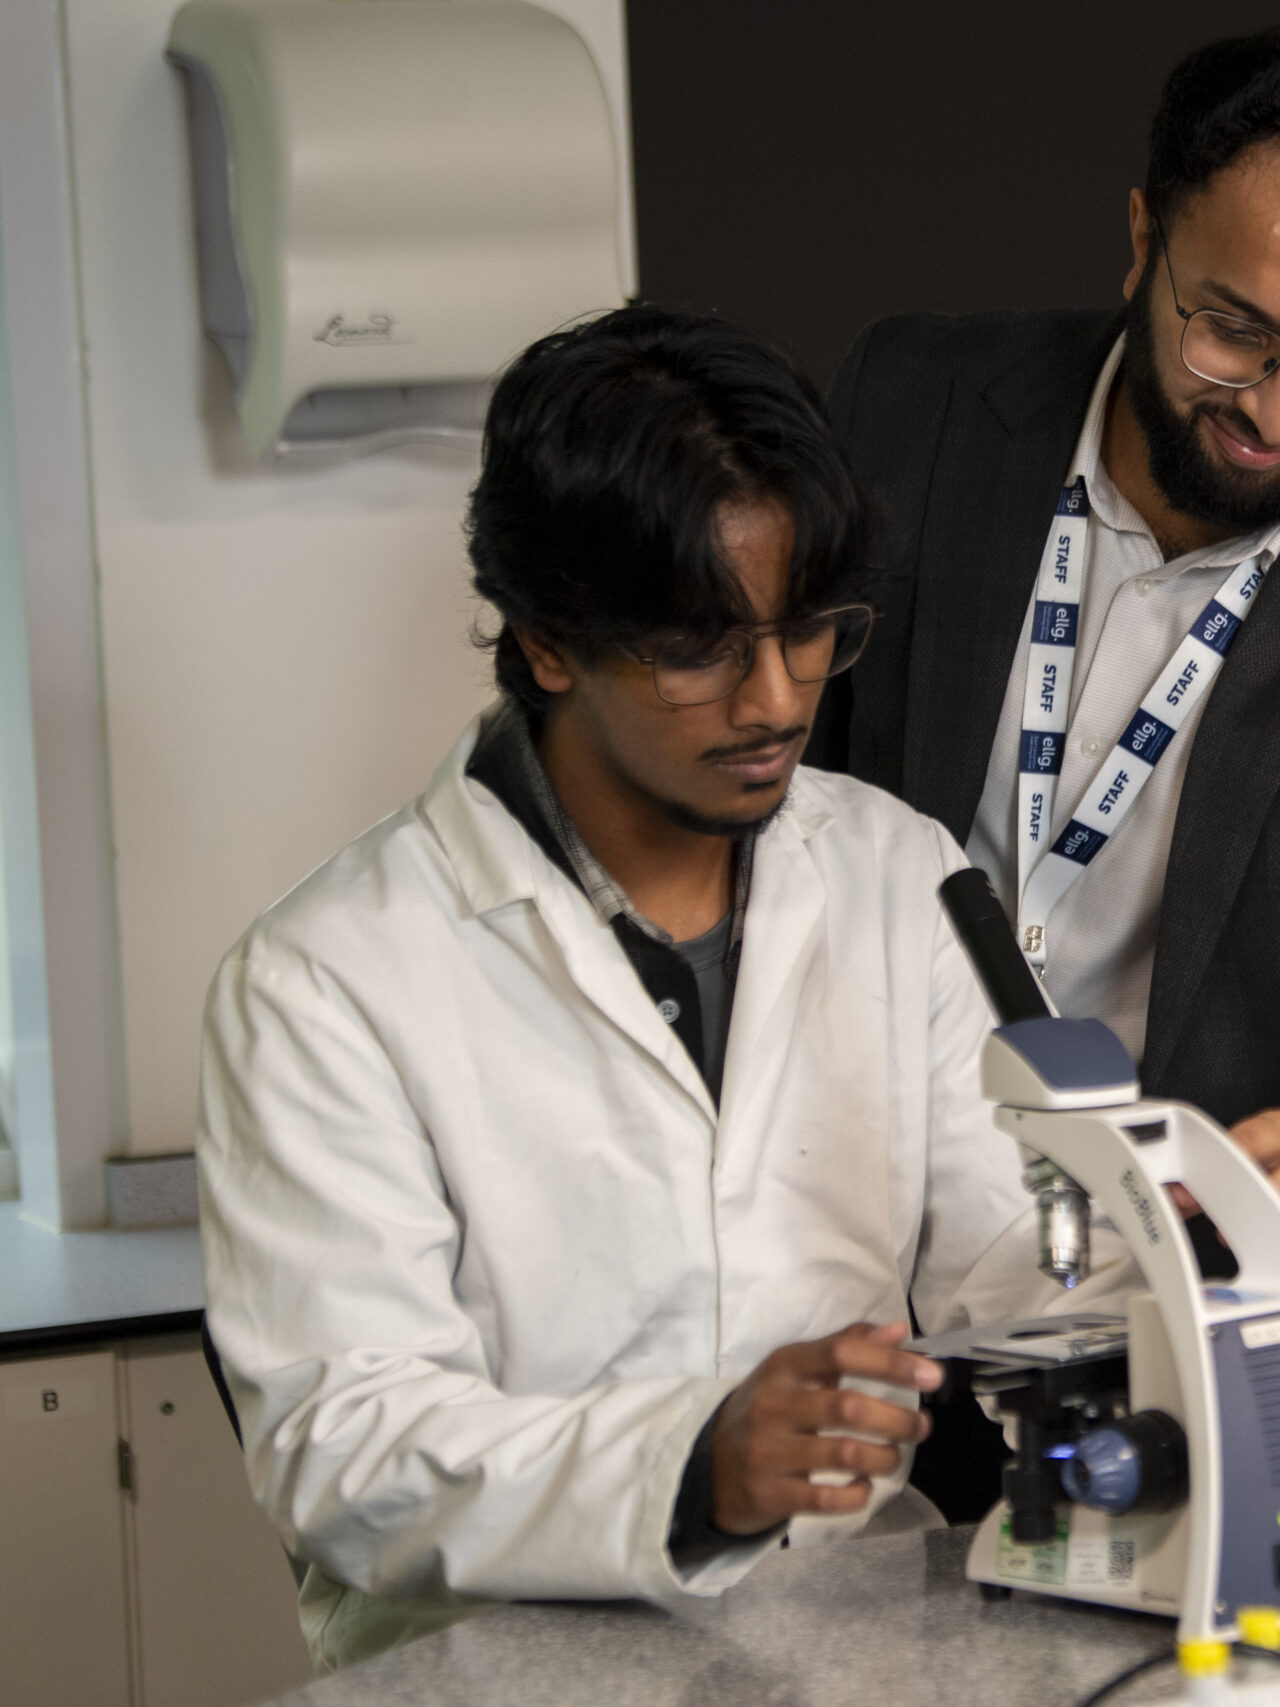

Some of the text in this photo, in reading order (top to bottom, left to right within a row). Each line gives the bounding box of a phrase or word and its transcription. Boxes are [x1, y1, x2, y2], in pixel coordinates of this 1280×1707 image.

[1054, 535, 1071, 584] STAFF
[1239, 566, 1266, 600] STA
[1050, 608, 1070, 642] ellg.
[1203, 613, 1229, 641] ellg.
[1040, 664, 1057, 713] STAFF
[1166, 660, 1199, 707] STAFF
[1037, 736, 1056, 770] ellg.
[1131, 721, 1157, 751] ellg.
[1098, 770, 1129, 815] STAFF
[1029, 793, 1043, 842] STAFF
[1064, 830, 1089, 855] ellg.
[43, 1391, 59, 1412] B
